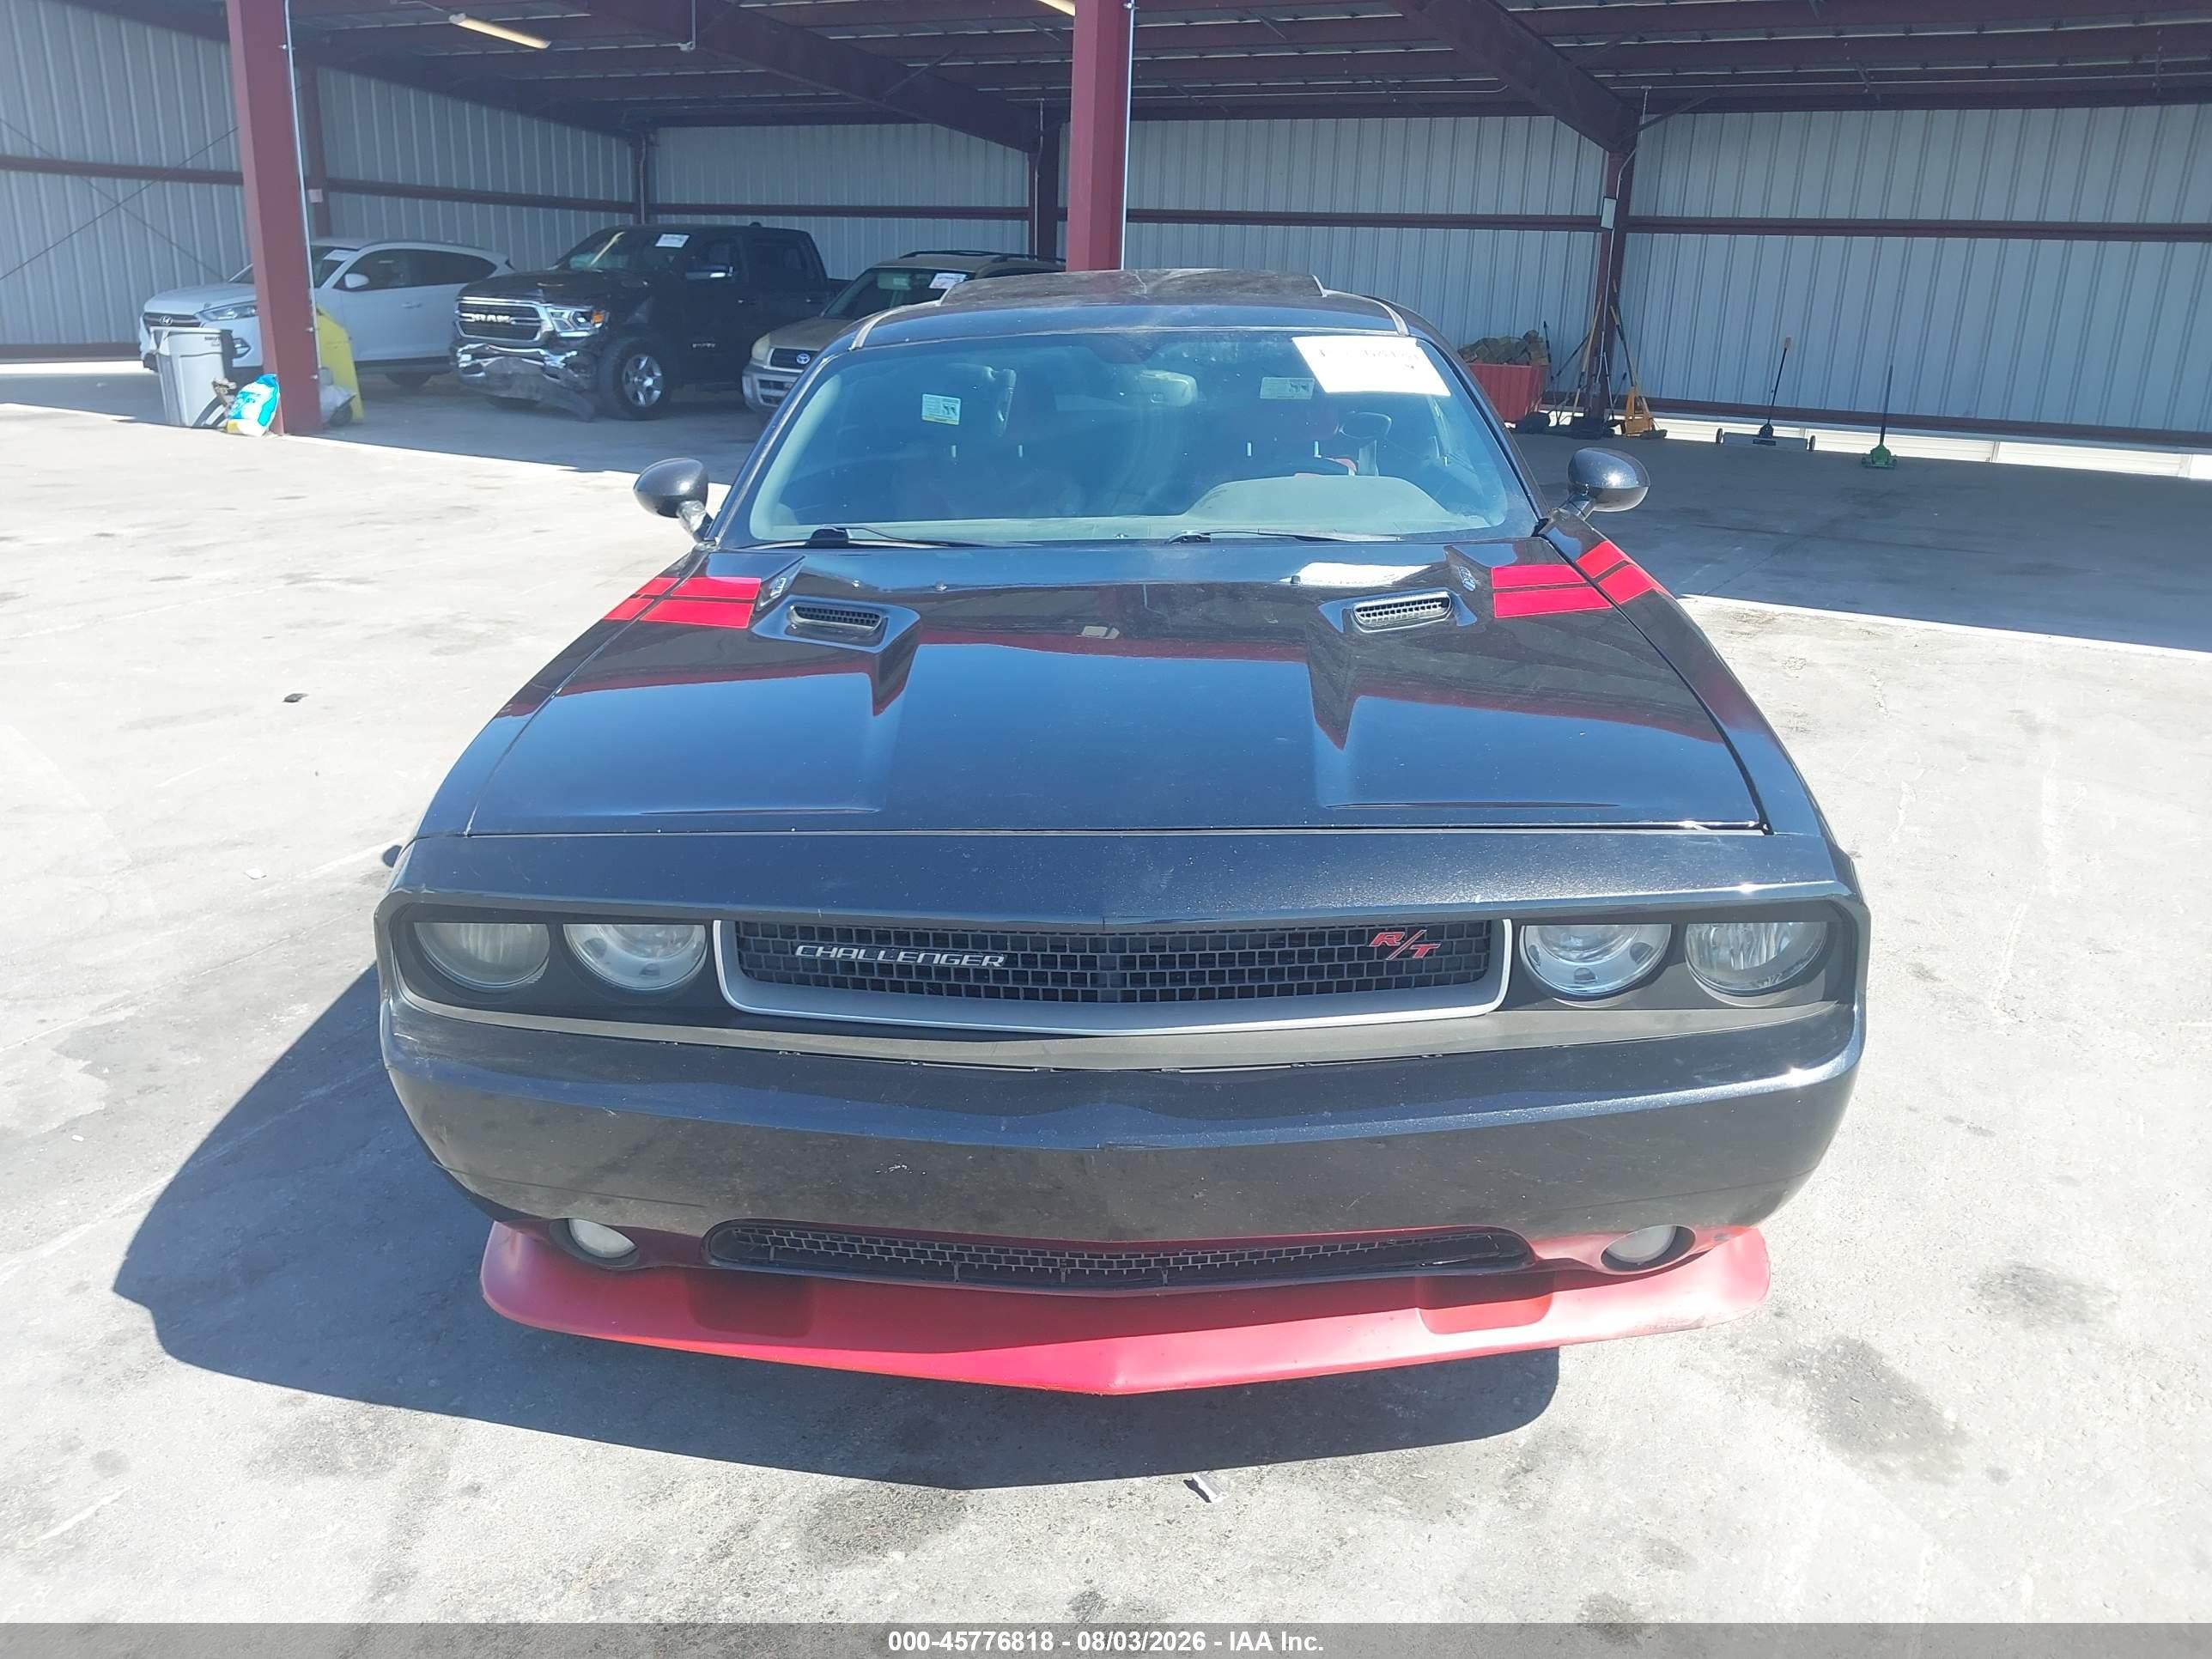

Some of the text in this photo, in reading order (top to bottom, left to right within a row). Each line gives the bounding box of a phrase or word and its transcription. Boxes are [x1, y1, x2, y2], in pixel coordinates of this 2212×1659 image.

[474, 313, 510, 323] RAM
[795, 945, 1006, 968] CHALLENGER
[1369, 929, 1441, 961] R/T
